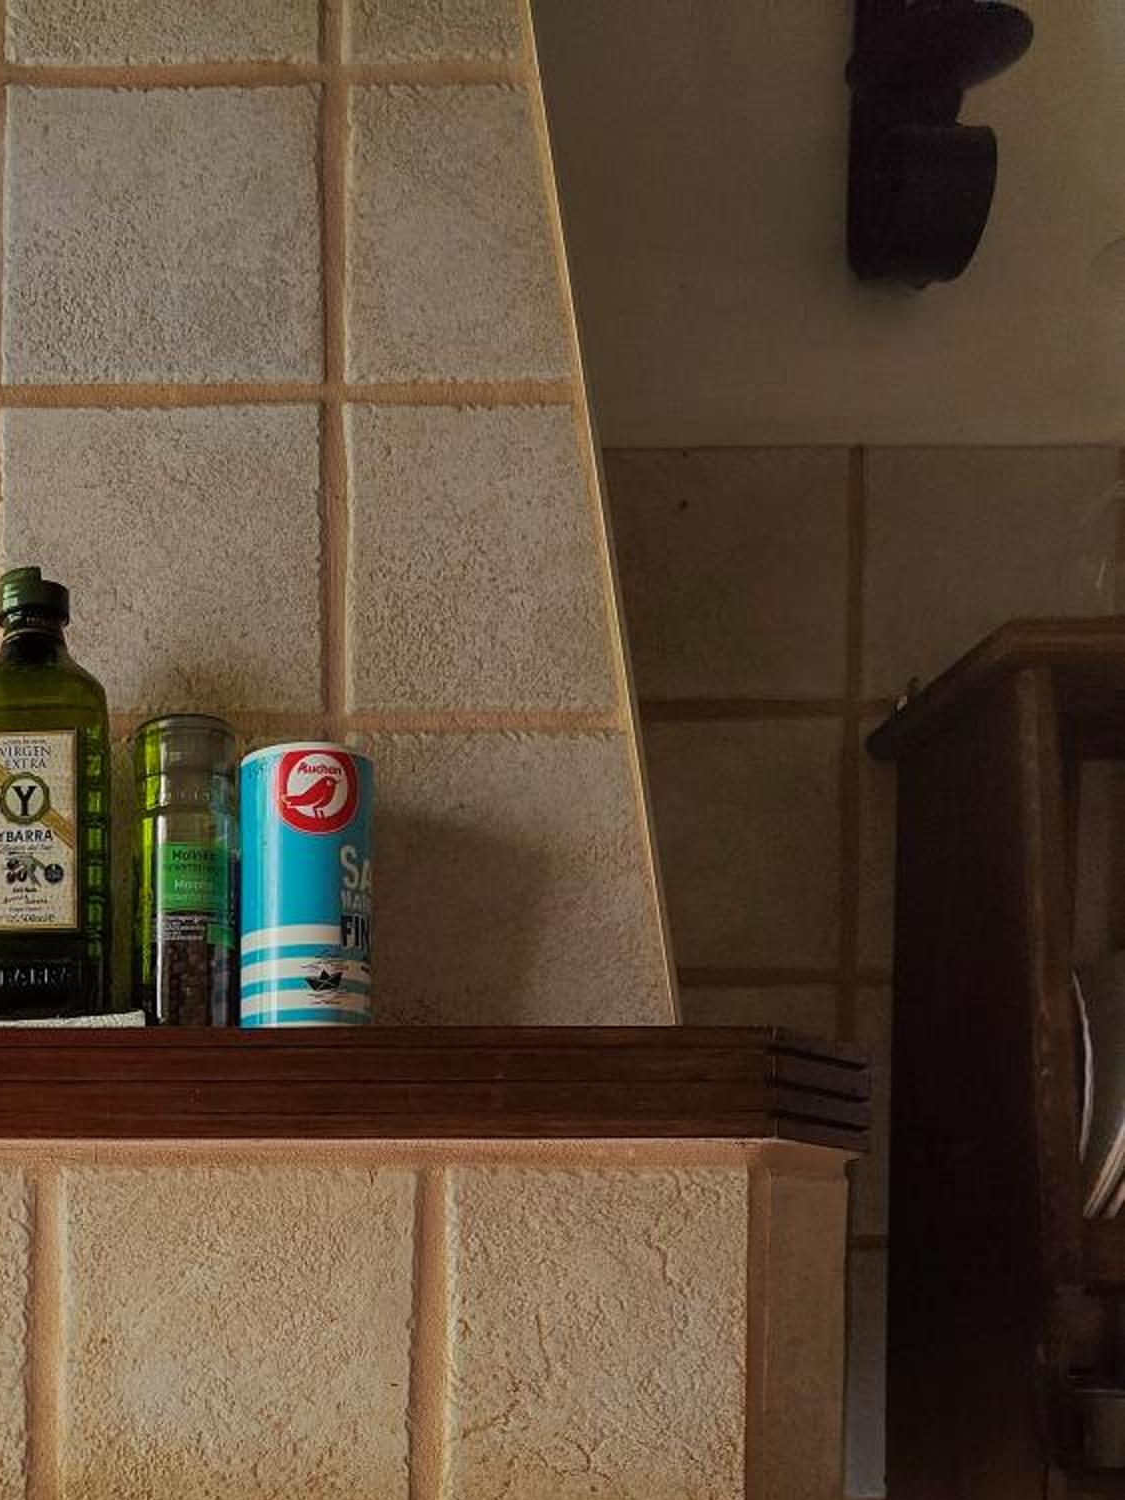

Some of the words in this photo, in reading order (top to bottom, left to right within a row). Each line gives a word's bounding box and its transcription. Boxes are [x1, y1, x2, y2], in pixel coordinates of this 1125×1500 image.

[0, 745, 51, 757] VIRGEN
[5, 758, 47, 771] EXTRA
[297, 761, 343, 776] Auchan
[12, 785, 37, 817] Y
